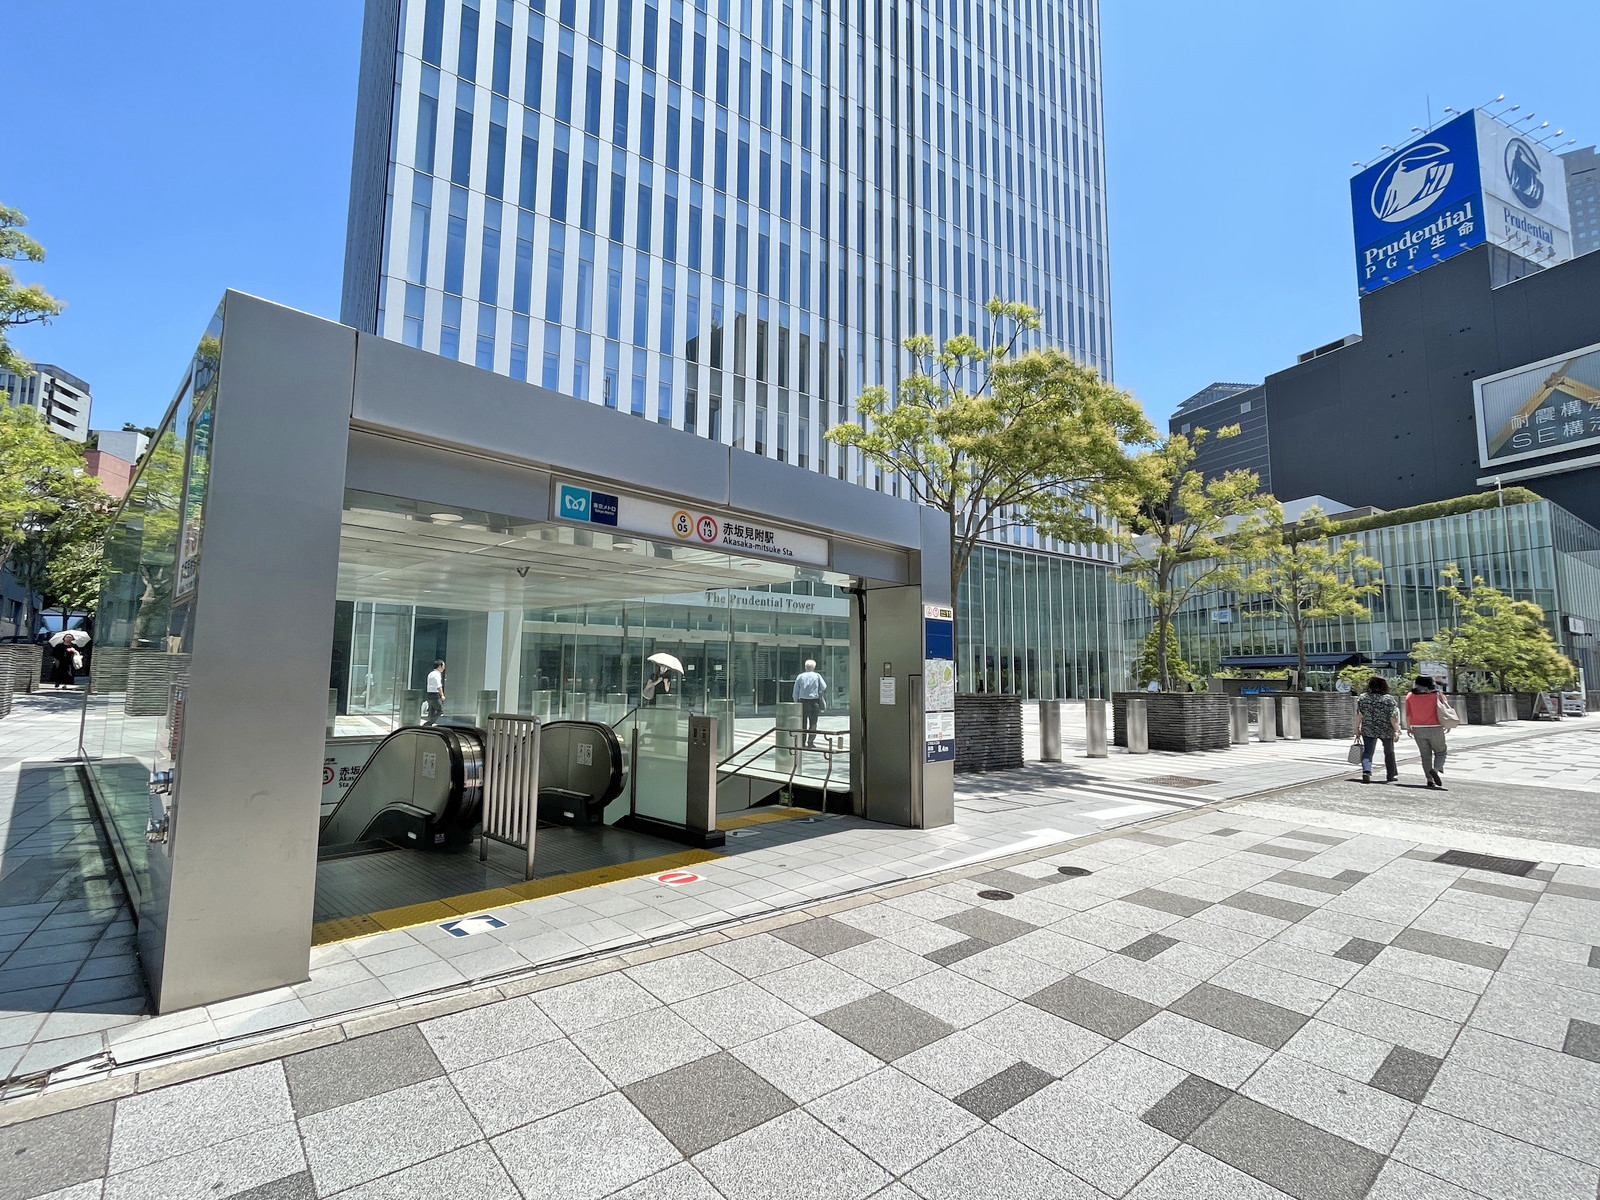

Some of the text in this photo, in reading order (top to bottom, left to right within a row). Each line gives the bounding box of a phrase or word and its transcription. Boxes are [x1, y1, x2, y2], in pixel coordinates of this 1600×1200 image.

[1364, 202, 1473, 267] Prudential
[1504, 207, 1553, 245] Prudential
[677, 523, 688, 533] 05
[680, 515, 686, 523] G
[703, 521, 711, 529] M
[703, 529, 712, 538] 13
[722, 522, 774, 544] 赤坂見附駅
[722, 536, 794, 556] Akasaka-mitsuke Sta.
[705, 592, 815, 610] The Prudential Tower
